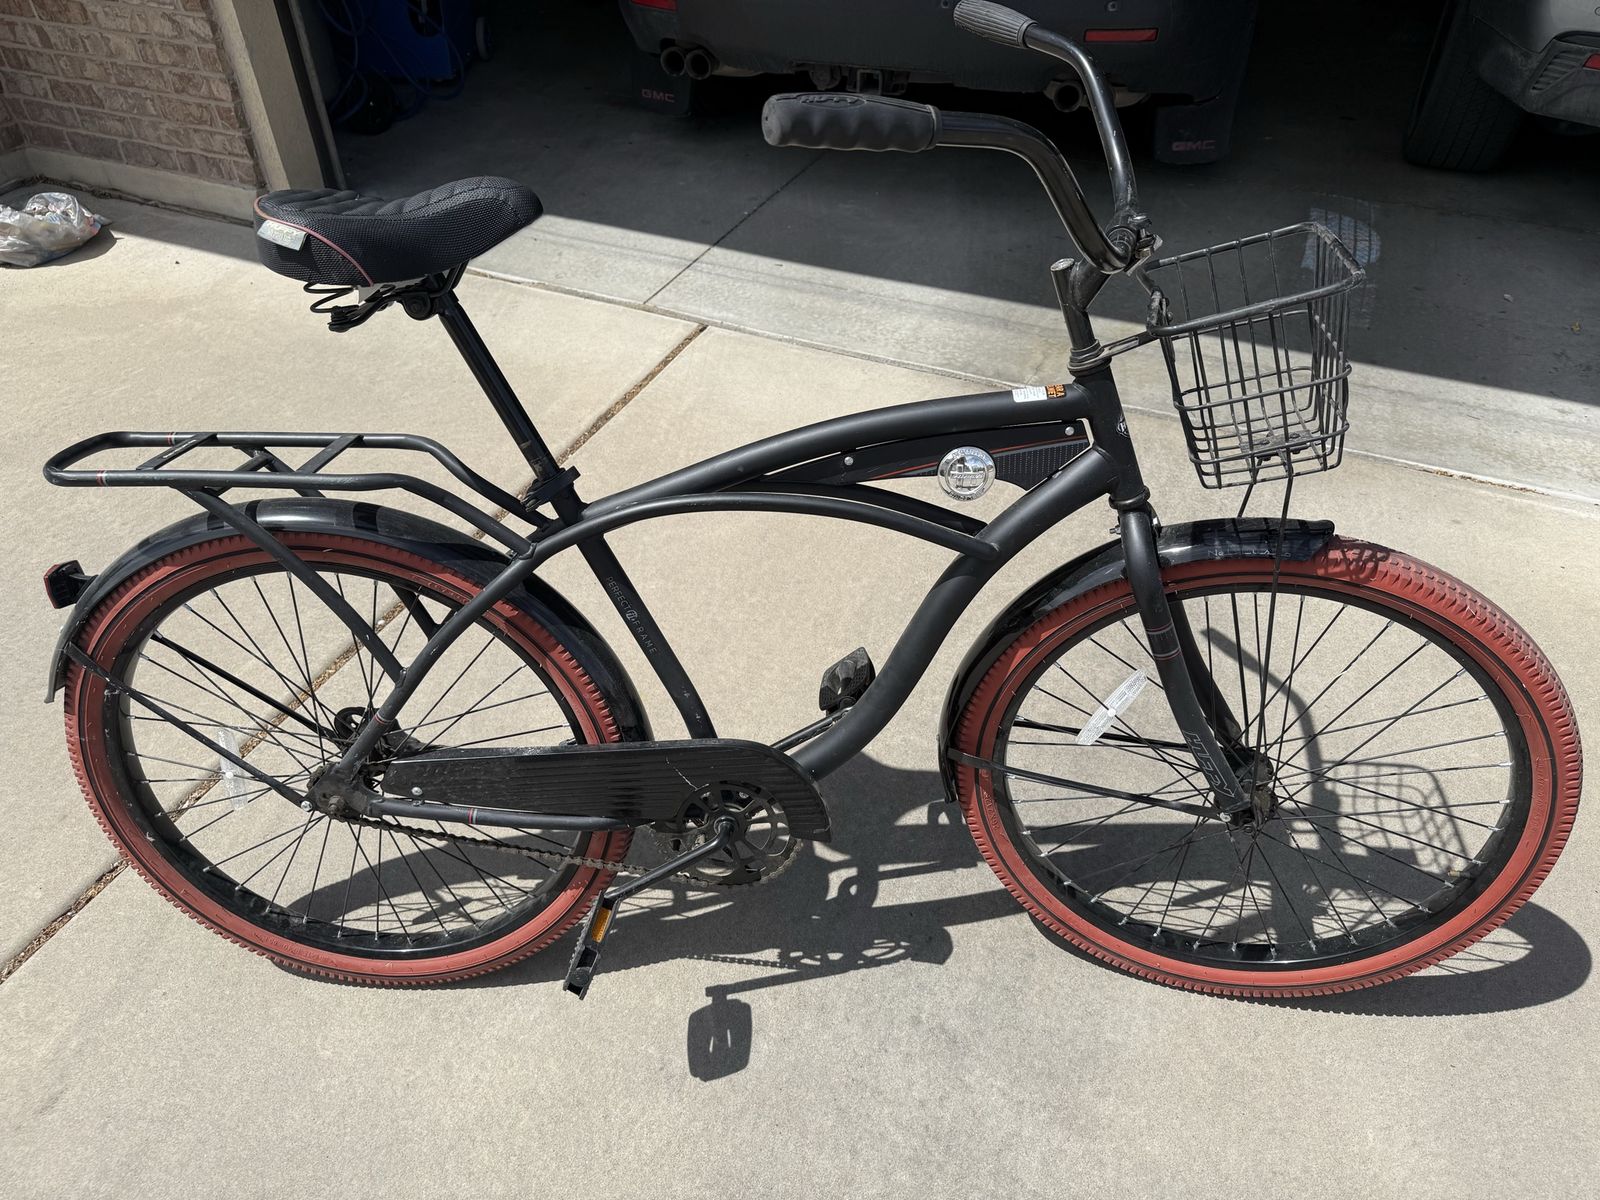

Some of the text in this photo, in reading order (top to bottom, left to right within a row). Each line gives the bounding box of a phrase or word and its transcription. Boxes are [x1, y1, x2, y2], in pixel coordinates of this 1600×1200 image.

[641, 88, 675, 103] GMC
[1172, 140, 1216, 151] GMC
[606, 576, 633, 611] PERFECT
[633, 619, 658, 655] FRAME
